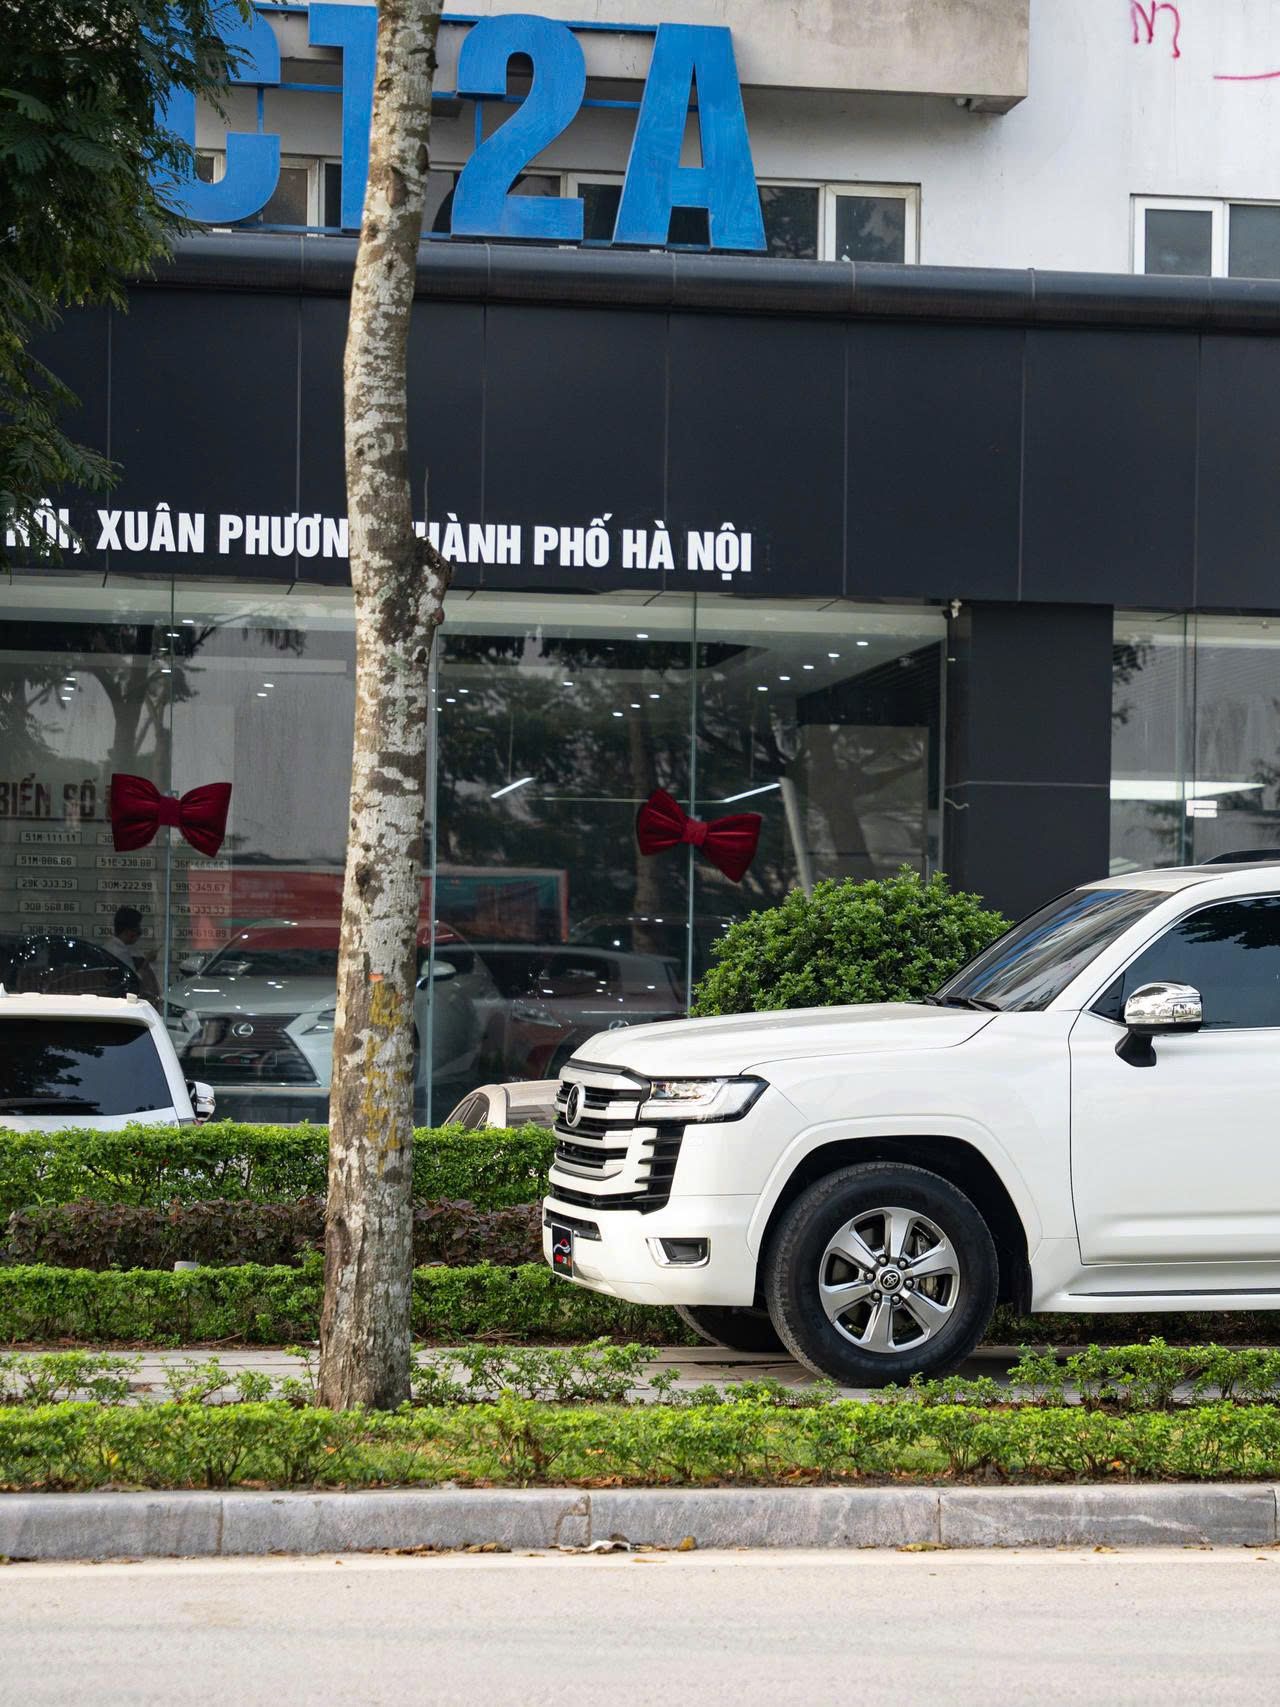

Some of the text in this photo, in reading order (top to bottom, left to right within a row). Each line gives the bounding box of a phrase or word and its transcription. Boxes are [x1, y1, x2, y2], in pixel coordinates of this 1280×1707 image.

[96, 502, 205, 553] XUÂN
[219, 512, 348, 558] PHƯƠN
[411, 512, 521, 565] HÀNH
[533, 512, 613, 568] PHỐ
[621, 519, 675, 570] HÀ
[687, 521, 752, 581] NỘI
